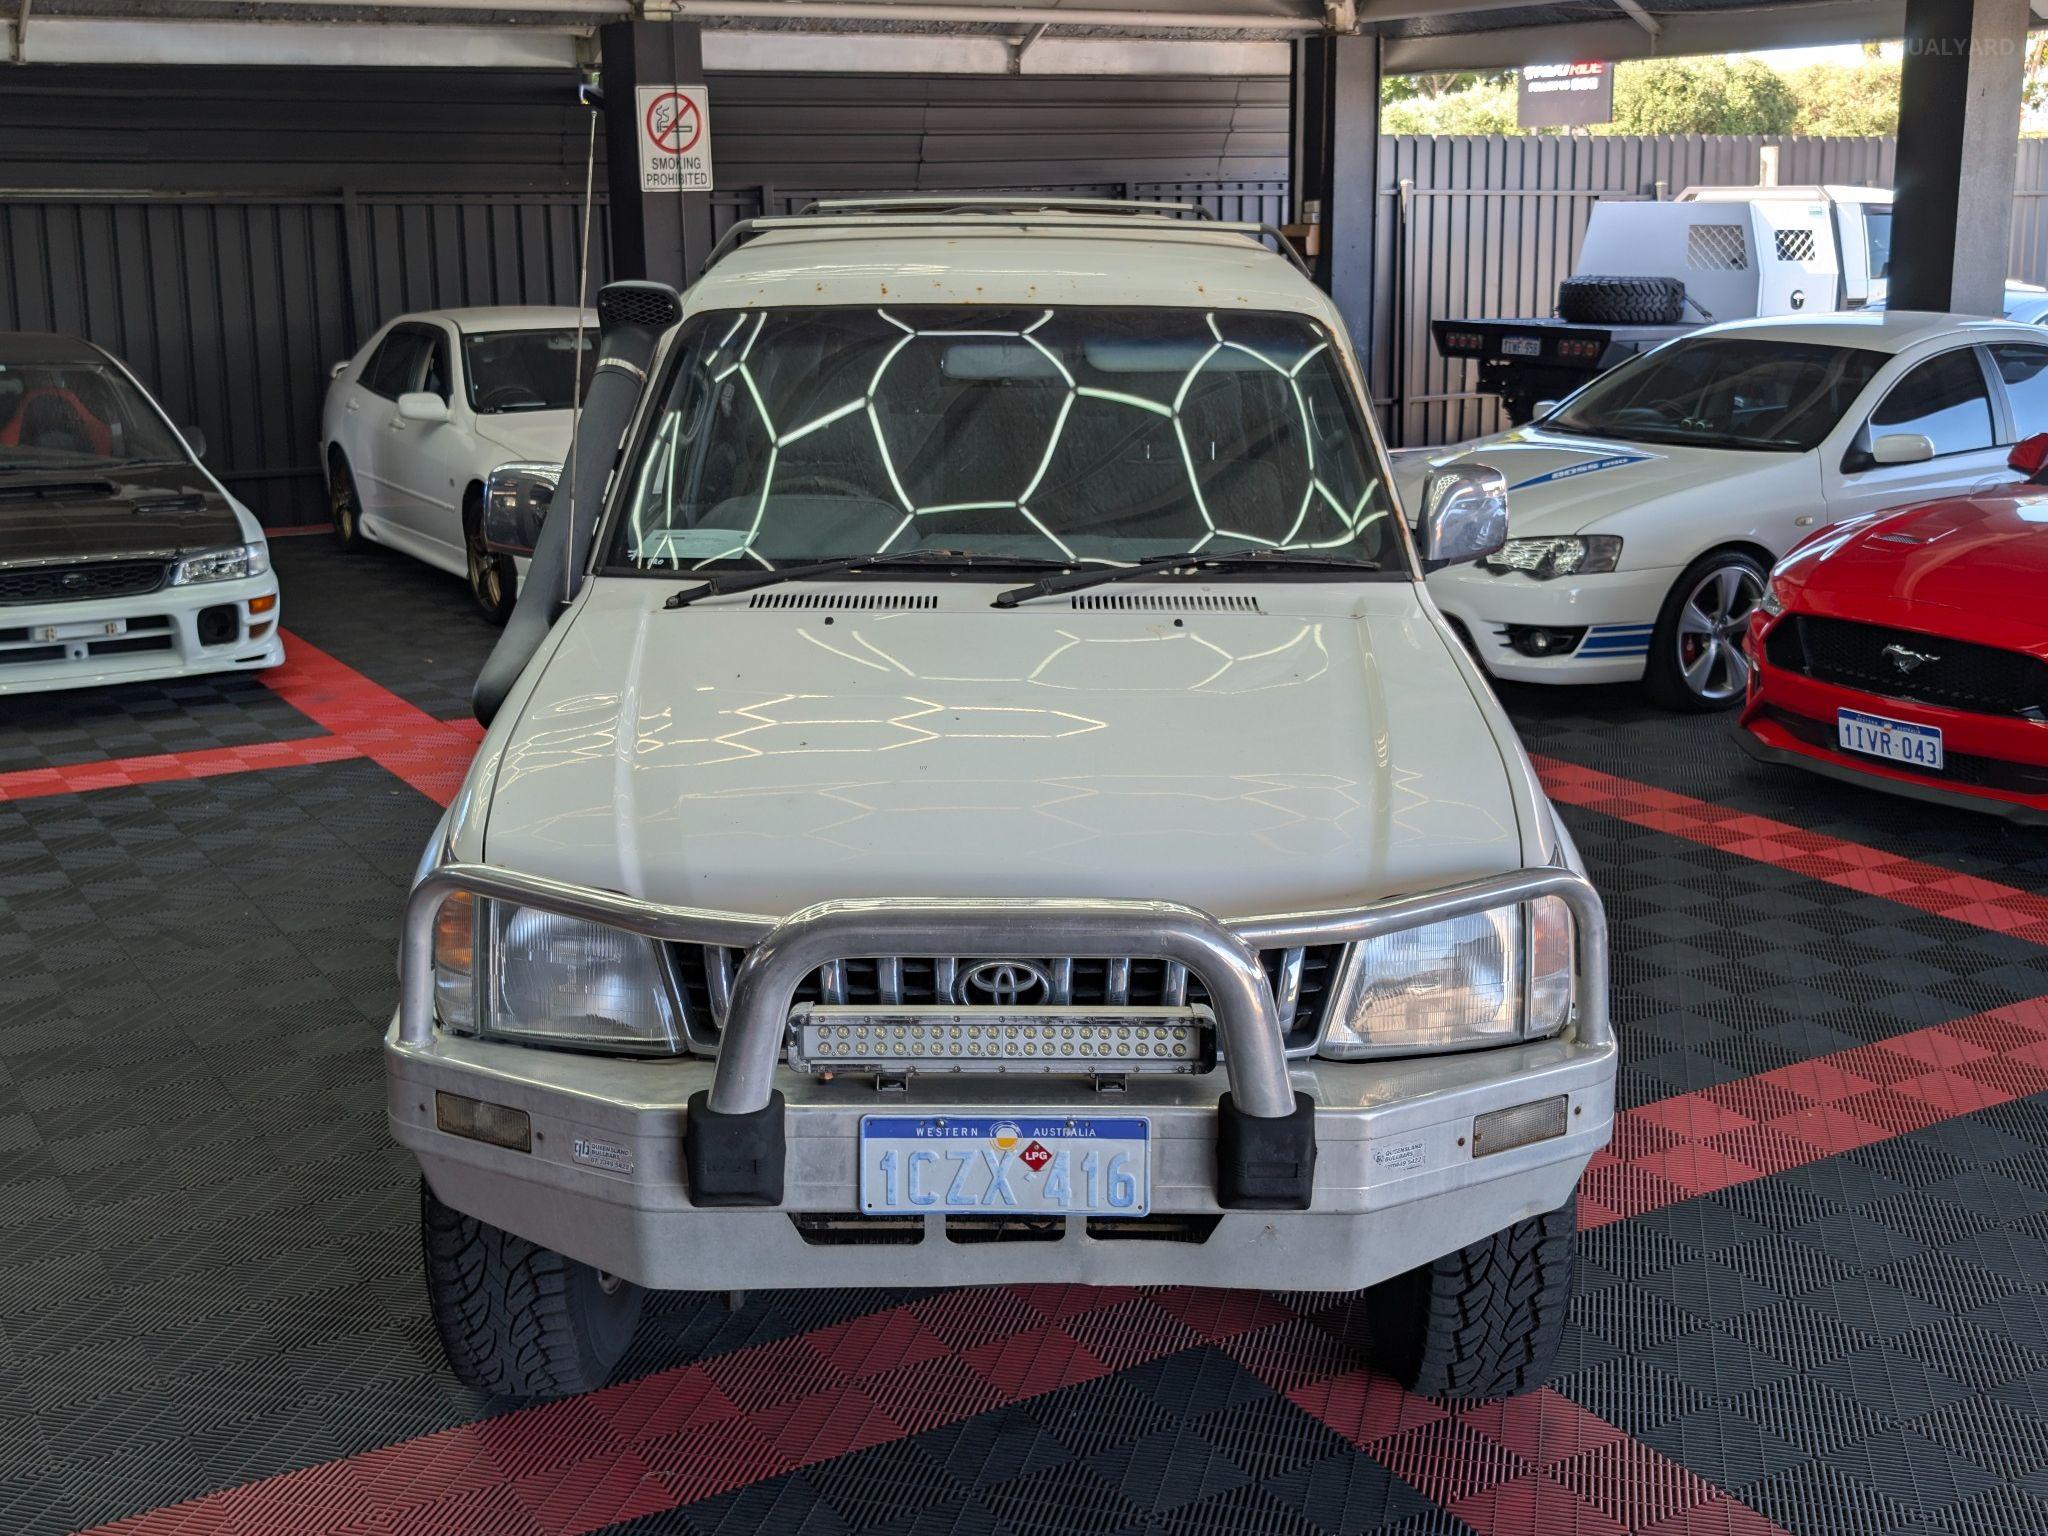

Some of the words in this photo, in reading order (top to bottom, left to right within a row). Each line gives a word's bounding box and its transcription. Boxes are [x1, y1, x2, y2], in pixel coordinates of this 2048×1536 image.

[652, 157, 701, 170] SMOKING
[646, 173, 707, 186] PROHIBITED
[916, 1127, 978, 1137] WESTERN
[1033, 1127, 1097, 1138] AUSTRALIA
[591, 1143, 630, 1156] QUEENSLAND
[1025, 1151, 1048, 1161] LPG
[880, 1149, 1018, 1206] 1CZX
[1043, 1149, 1137, 1207] 416
